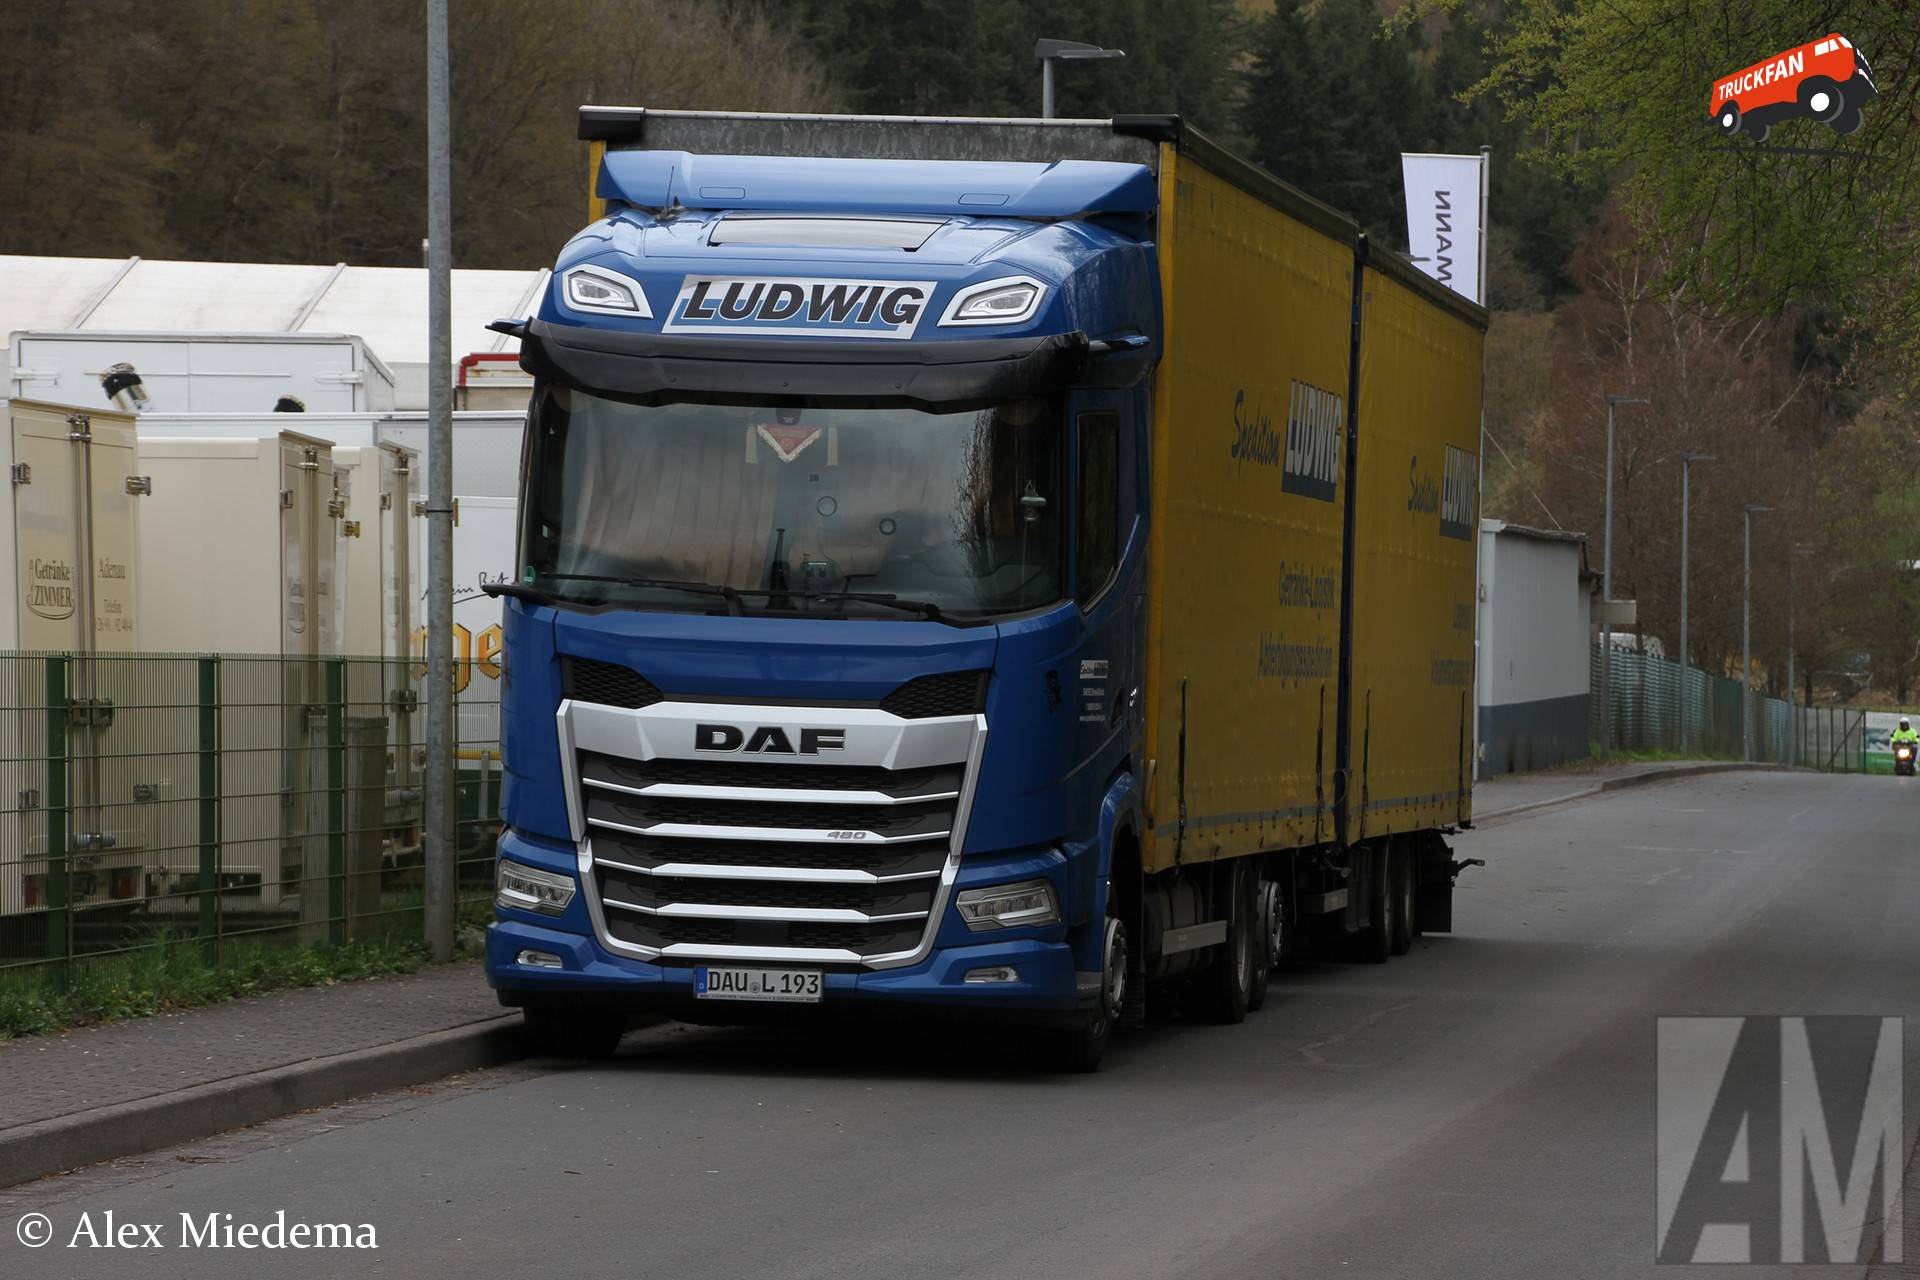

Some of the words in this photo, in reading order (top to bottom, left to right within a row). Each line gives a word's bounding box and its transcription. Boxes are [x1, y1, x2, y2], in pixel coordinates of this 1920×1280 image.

[681, 280, 925, 325] LUDWIG
[1284, 378, 1342, 486] LUDWIG
[34, 558, 70, 581] Getränke
[32, 585, 72, 608] ZIMMER
[695, 723, 846, 756] DAF
[708, 971, 748, 992] DAU
[762, 973, 775, 993] L
[780, 973, 819, 994] 193
